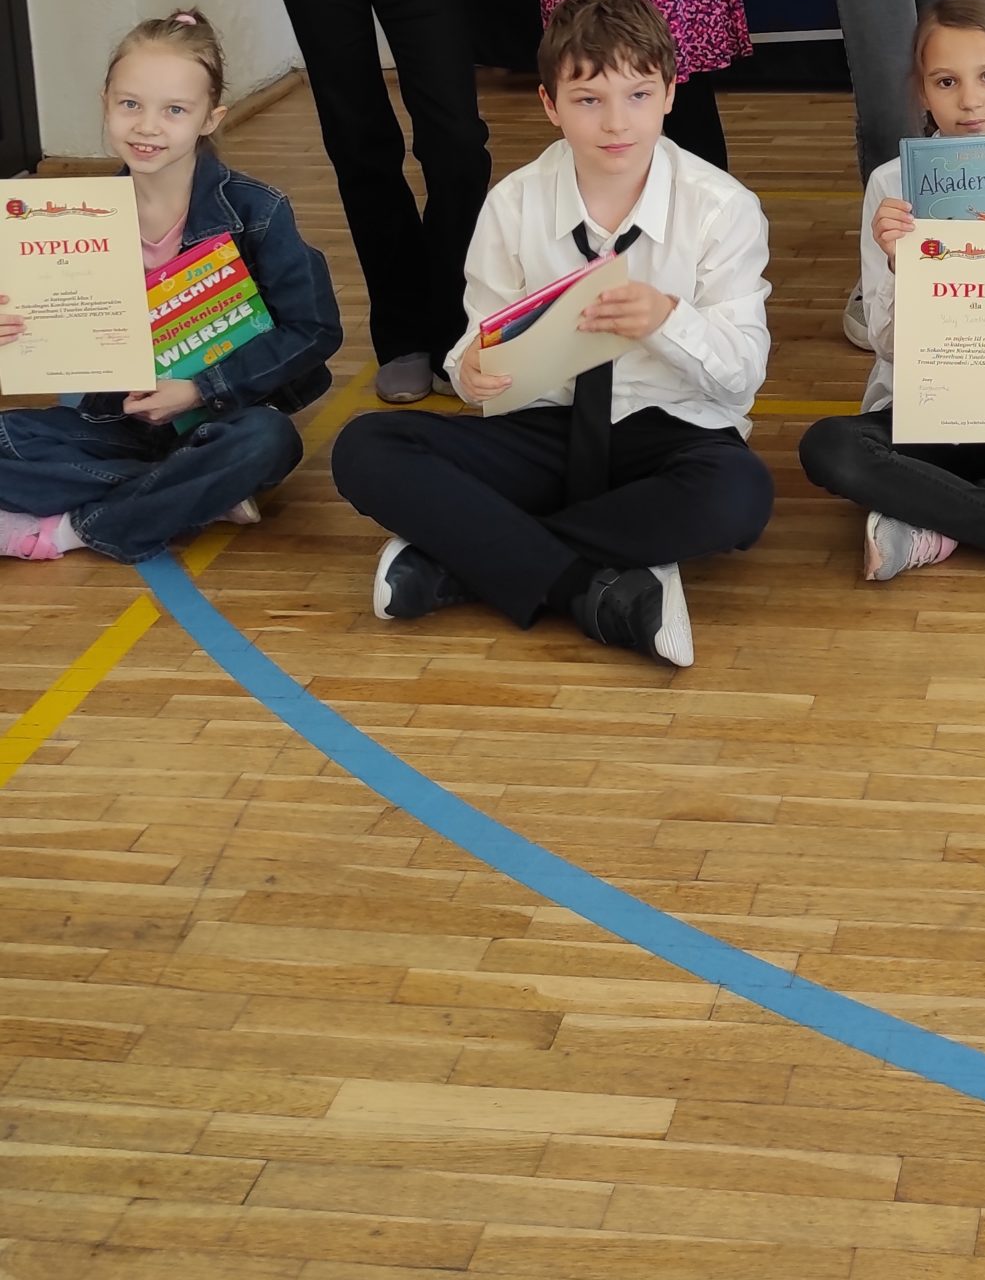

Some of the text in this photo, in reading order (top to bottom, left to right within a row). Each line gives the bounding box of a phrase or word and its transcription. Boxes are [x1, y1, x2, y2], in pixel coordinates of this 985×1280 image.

[19, 237, 110, 256] DYPLOM
[56, 258, 69, 266] dla
[185, 262, 213, 282] Jan
[149, 265, 236, 321] RZECHWA
[155, 301, 254, 367] WIERSZE
[203, 339, 234, 365] dla
